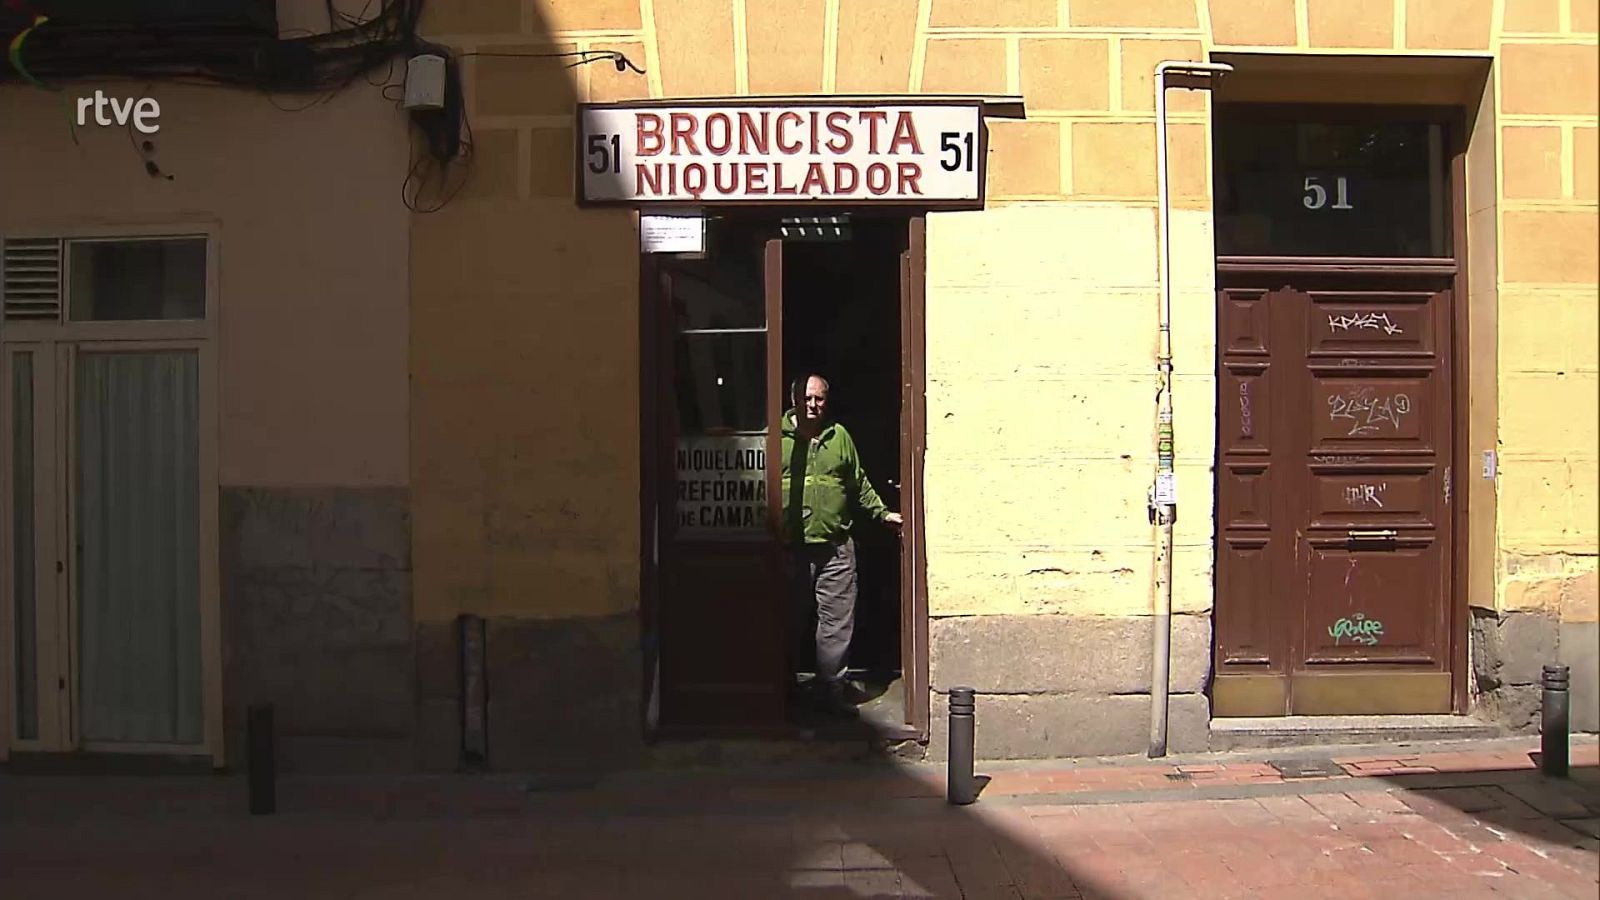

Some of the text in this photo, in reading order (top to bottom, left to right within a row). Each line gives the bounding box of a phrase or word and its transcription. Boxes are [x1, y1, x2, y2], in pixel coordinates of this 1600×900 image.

[634, 111, 925, 156] BRONCISTA
[940, 131, 973, 172] 51
[588, 134, 621, 174] 51
[634, 162, 924, 200] NIQUELADOR
[1303, 176, 1354, 209] 51
